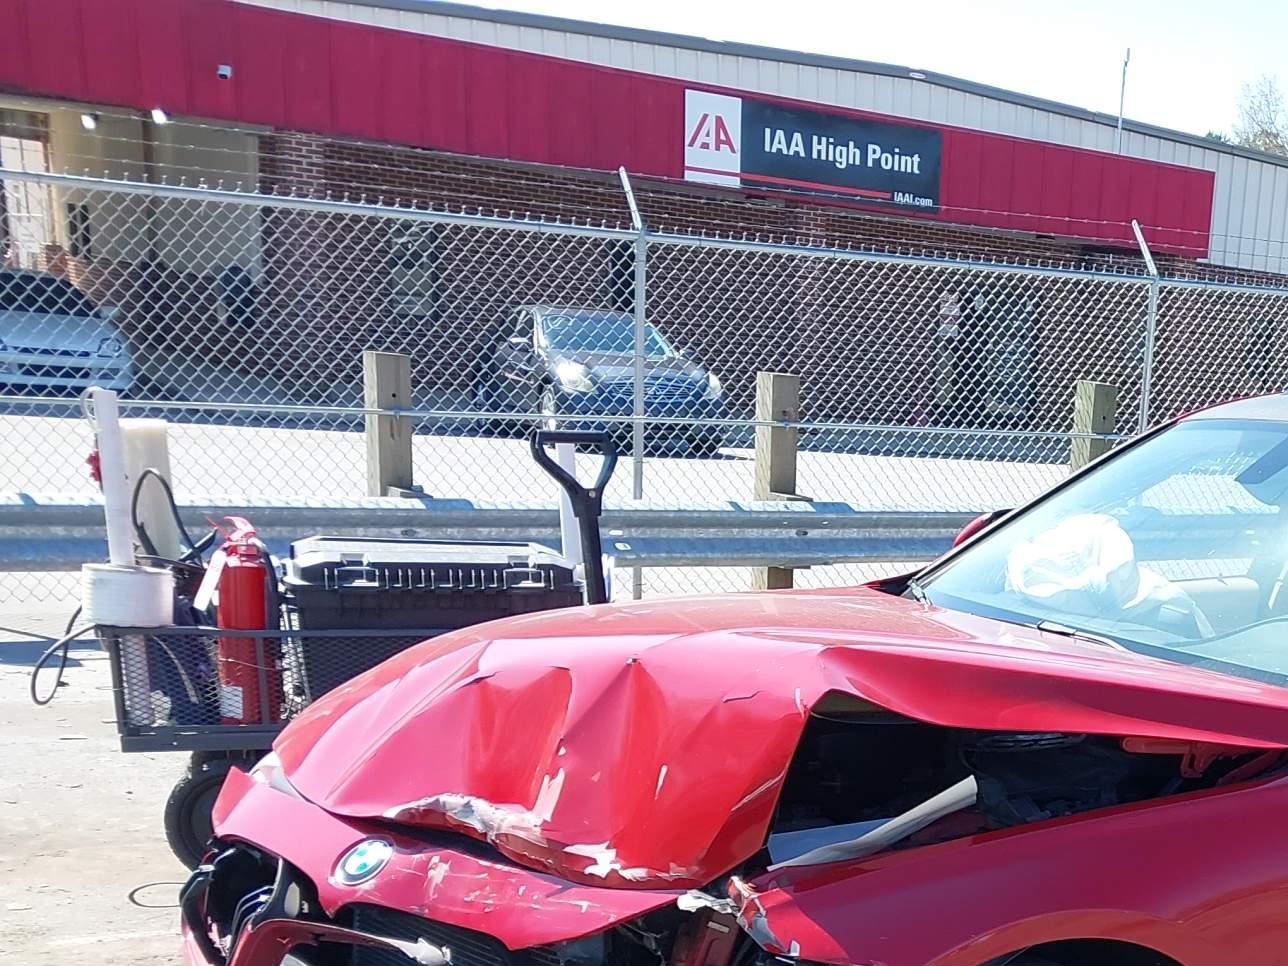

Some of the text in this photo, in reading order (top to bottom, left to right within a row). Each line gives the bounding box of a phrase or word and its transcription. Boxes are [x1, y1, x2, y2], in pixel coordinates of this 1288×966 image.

[764, 127, 921, 174] IAA High Point
[893, 191, 933, 207] IAAI.com
